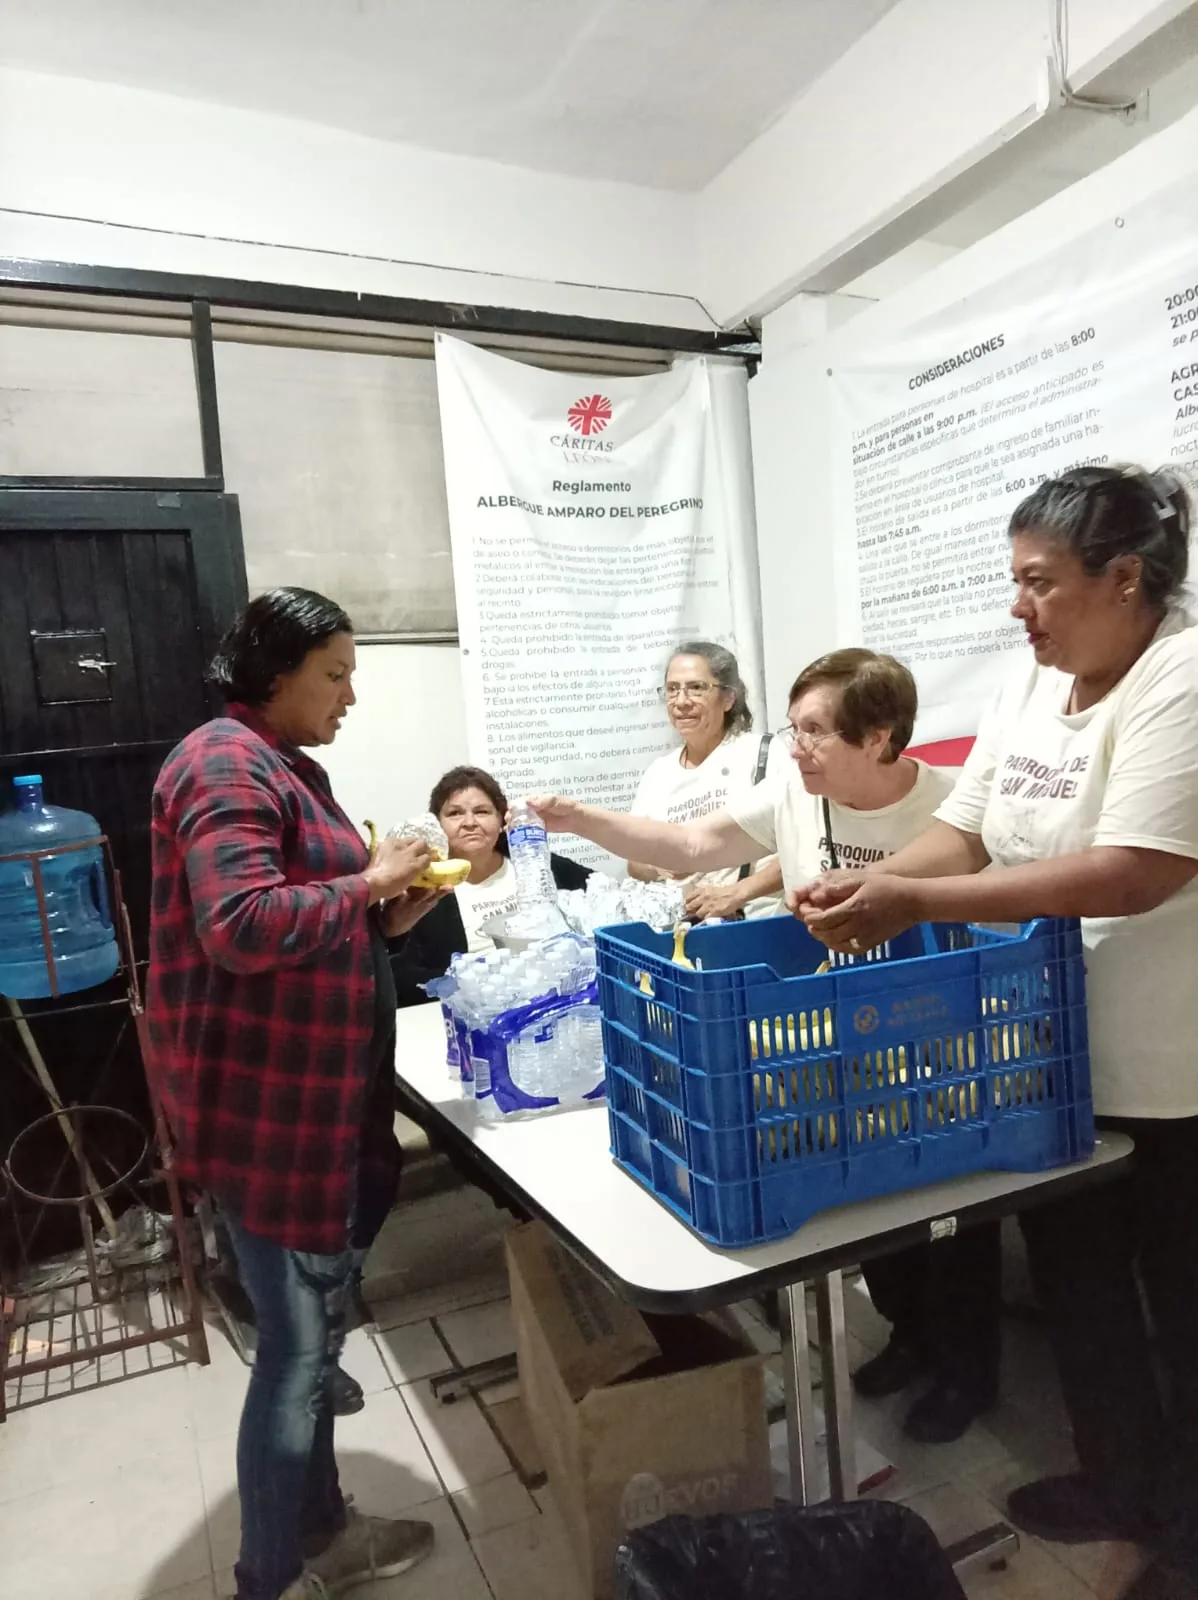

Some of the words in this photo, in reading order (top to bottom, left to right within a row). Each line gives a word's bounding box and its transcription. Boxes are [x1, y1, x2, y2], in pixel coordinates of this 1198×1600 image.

[908, 333, 1005, 391] CONSIDERACIONES
[947, 390, 959, 400] de
[960, 372, 994, 396] hospital
[995, 370, 1006, 381] es
[1007, 367, 1014, 376] a
[1014, 354, 1039, 374] partir
[1041, 347, 1054, 360] de
[1055, 340, 1070, 354] las
[1071, 327, 1096, 347] 8:00
[852, 447, 886, 465] situación
[887, 440, 896, 452] de
[899, 434, 915, 447] calle
[917, 431, 922, 440] a
[923, 425, 935, 436] las
[936, 414, 954, 431] 9:00
[957, 408, 978, 424] p.m.
[995, 390, 1030, 409] acceso
[1032, 367, 1089, 396] anticipado
[1092, 360, 1105, 372] es
[960, 422, 976, 436] que
[977, 404, 1027, 428] determina
[875, 431, 890, 445] para
[890, 416, 922, 439] personas
[923, 412, 934, 422] en
[550, 433, 614, 453] CÁRITAS
[931, 450, 983, 476] comprobante
[984, 443, 995, 456] de
[996, 432, 1030, 451] ingreso
[1031, 427, 1043, 439] de
[1045, 412, 1084, 433] familiar
[1085, 407, 1101, 420] in-
[974, 462, 990, 475] que
[1000, 453, 1016, 465] sea
[1017, 437, 1061, 458] asignada
[1062, 429, 1084, 444] una
[553, 480, 632, 494] Reglamento
[931, 505, 941, 515] es
[943, 503, 949, 512] a
[950, 495, 974, 512] partir
[976, 491, 988, 502] de
[990, 486, 1003, 497] las
[1005, 478, 1026, 493] 6:00
[958, 483, 969, 494] de
[477, 495, 545, 516] ALBERGUE
[547, 506, 606, 519] AMPARO
[609, 506, 635, 519] DEL
[877, 533, 888, 544] las
[888, 527, 904, 541] 7:45
[905, 525, 922, 536] a.m.
[920, 533, 941, 545] entre
[943, 530, 948, 539] a
[950, 526, 963, 536] los
[944, 536, 976, 552] manera
[978, 532, 990, 543] en
[991, 528, 1000, 540] la
[633, 544, 645, 552] de
[970, 545, 996, 559] entrar
[941, 568, 955, 581] por
[956, 565, 964, 575] la
[966, 560, 993, 573] noche
[993, 557, 1005, 567] es
[861, 600, 873, 611] por
[873, 597, 880, 607] la
[881, 592, 910, 605] mañana
[911, 588, 921, 599] de
[922, 583, 940, 597] 6:00
[941, 581, 959, 593] a.m.
[960, 579, 966, 589] a
[967, 573, 986, 587] 7:00
[987, 571, 1007, 583] a.m.
[974, 589, 985, 599] no
[955, 605, 966, 617] En
[968, 603, 979, 615] su
[479, 623, 542, 633] pertenencias
[544, 621, 558, 630] de
[977, 630, 992, 642] por
[491, 635, 523, 646] Queda
[525, 632, 574, 644] prohibido
[526, 645, 576, 657] prohibido
[938, 649, 953, 660] que
[954, 648, 966, 657] no
[967, 639, 1001, 655] deberá
[495, 672, 507, 681] Se
[550, 669, 560, 679] la
[563, 668, 598, 678] entrada
[607, 666, 648, 677] personas
[483, 686, 506, 696] bajo
[517, 684, 531, 692] los
[532, 681, 569, 692] efectos
[570, 680, 583, 690] de
[515, 693, 584, 705] estrictamente
[549, 704, 596, 714] consumir
[598, 700, 640, 712] cualquier
[641, 699, 657, 709] tipo
[499, 733, 516, 743] Los
[518, 730, 564, 741] alimentos
[565, 729, 585, 739] que
[616, 722, 649, 734] ingresar
[488, 744, 514, 755] sonal
[516, 743, 529, 754] de
[530, 741, 576, 753] vigilancia.
[500, 756, 517, 766] Por
[520, 756, 531, 765] su
[532, 752, 584, 765] seguridad,
[585, 751, 598, 760] no
[599, 747, 631, 759] deberá
[1069, 755, 1089, 773] DE
[506, 779, 547, 790] Después
[549, 777, 562, 787] de
[563, 775, 571, 785] la
[573, 774, 595, 784] hora
[596, 772, 609, 782] de
[610, 768, 640, 781] dormir
[584, 782, 625, 794] molestar
[1000, 777, 1027, 796] SAN
[604, 796, 611, 804] o
